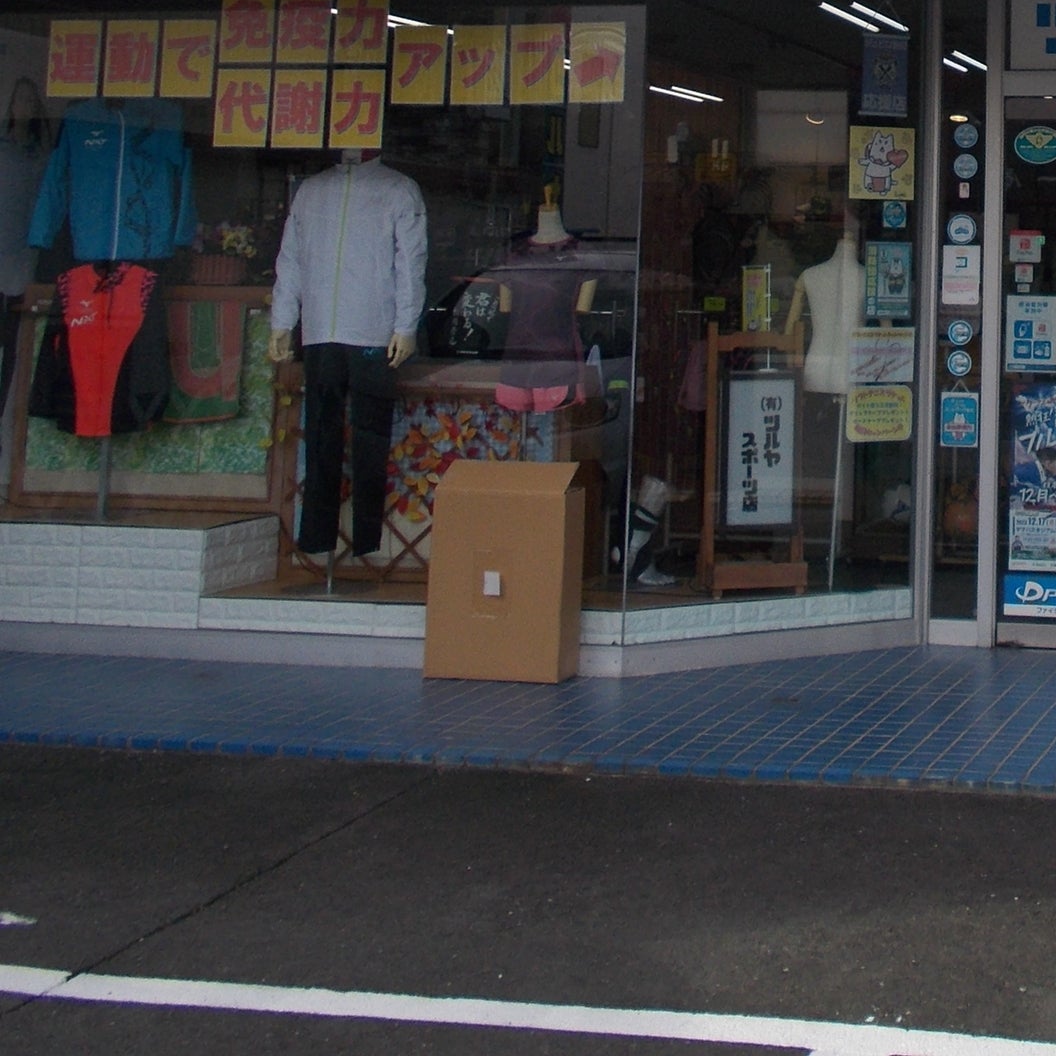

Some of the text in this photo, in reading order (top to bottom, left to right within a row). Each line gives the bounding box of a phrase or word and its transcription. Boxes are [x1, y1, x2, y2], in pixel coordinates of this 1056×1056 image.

[50, 32, 212, 86] 運動で
[398, 34, 565, 89] アップ
[217, 79, 383, 136] 代謝力
